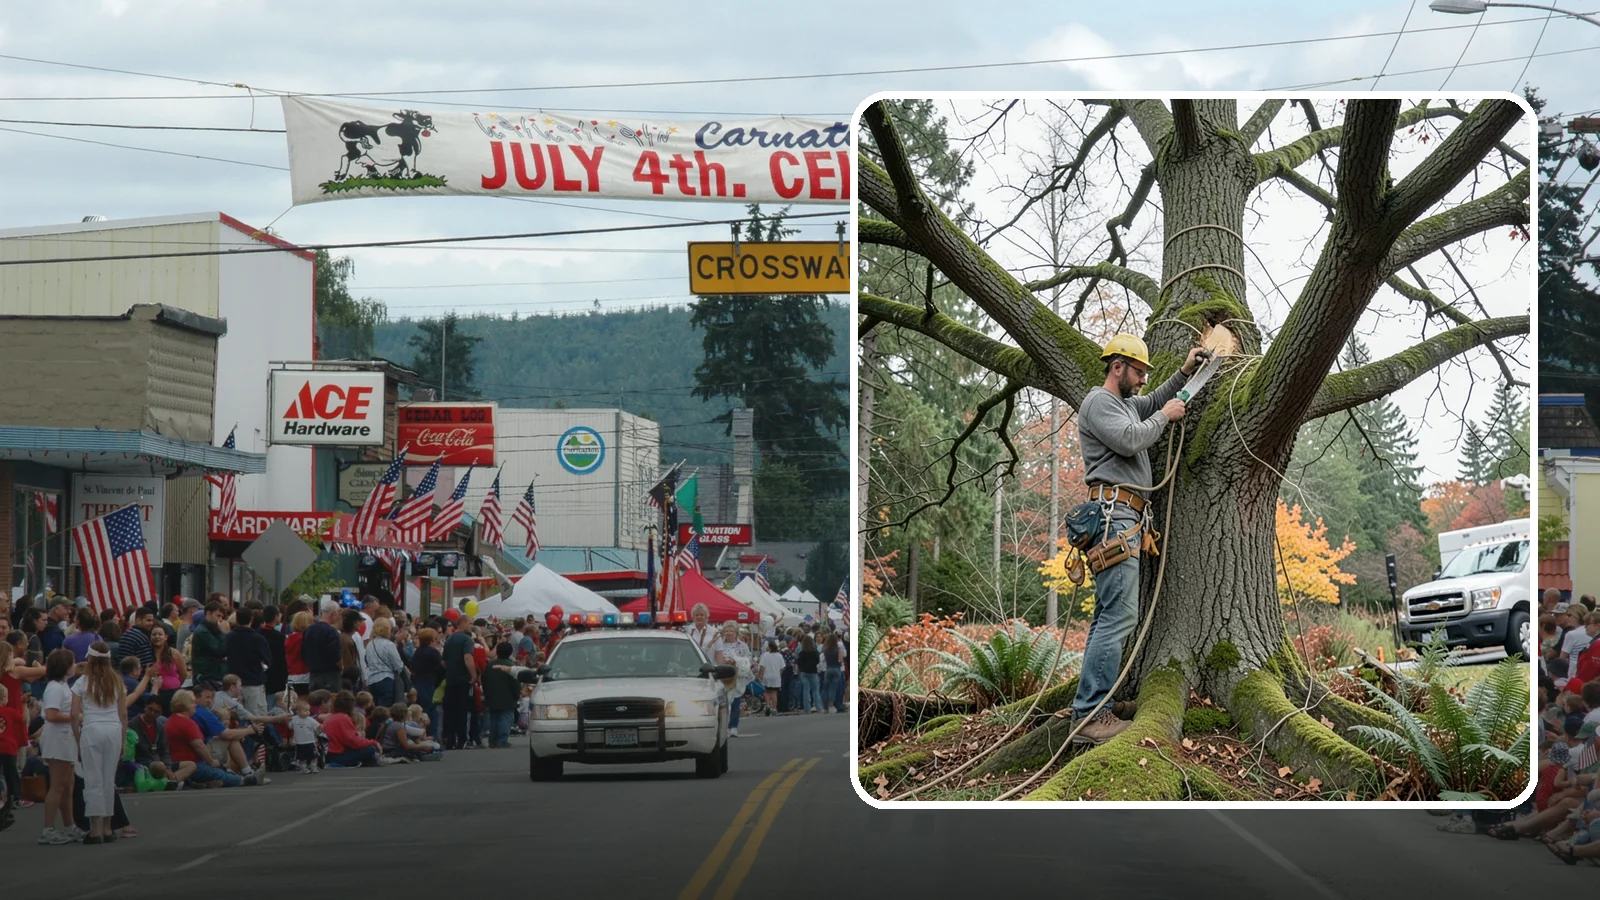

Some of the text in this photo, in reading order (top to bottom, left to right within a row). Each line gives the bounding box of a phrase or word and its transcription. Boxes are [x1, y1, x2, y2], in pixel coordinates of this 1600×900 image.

[481, 140, 605, 192] JULY
[632, 150, 746, 198] 4th.
[697, 254, 850, 280] CROSSWA
[283, 380, 373, 420] ACE
[406, 409, 452, 422] CEDAR
[283, 421, 370, 436] Hardware
[416, 428, 477, 447] Coca-Cola
[354, 467, 386, 480] Simpl
[83, 485, 155, 495] St. Vincent de Paul
[688, 526, 741, 535] CRNATION
[699, 535, 730, 543] GLASS
